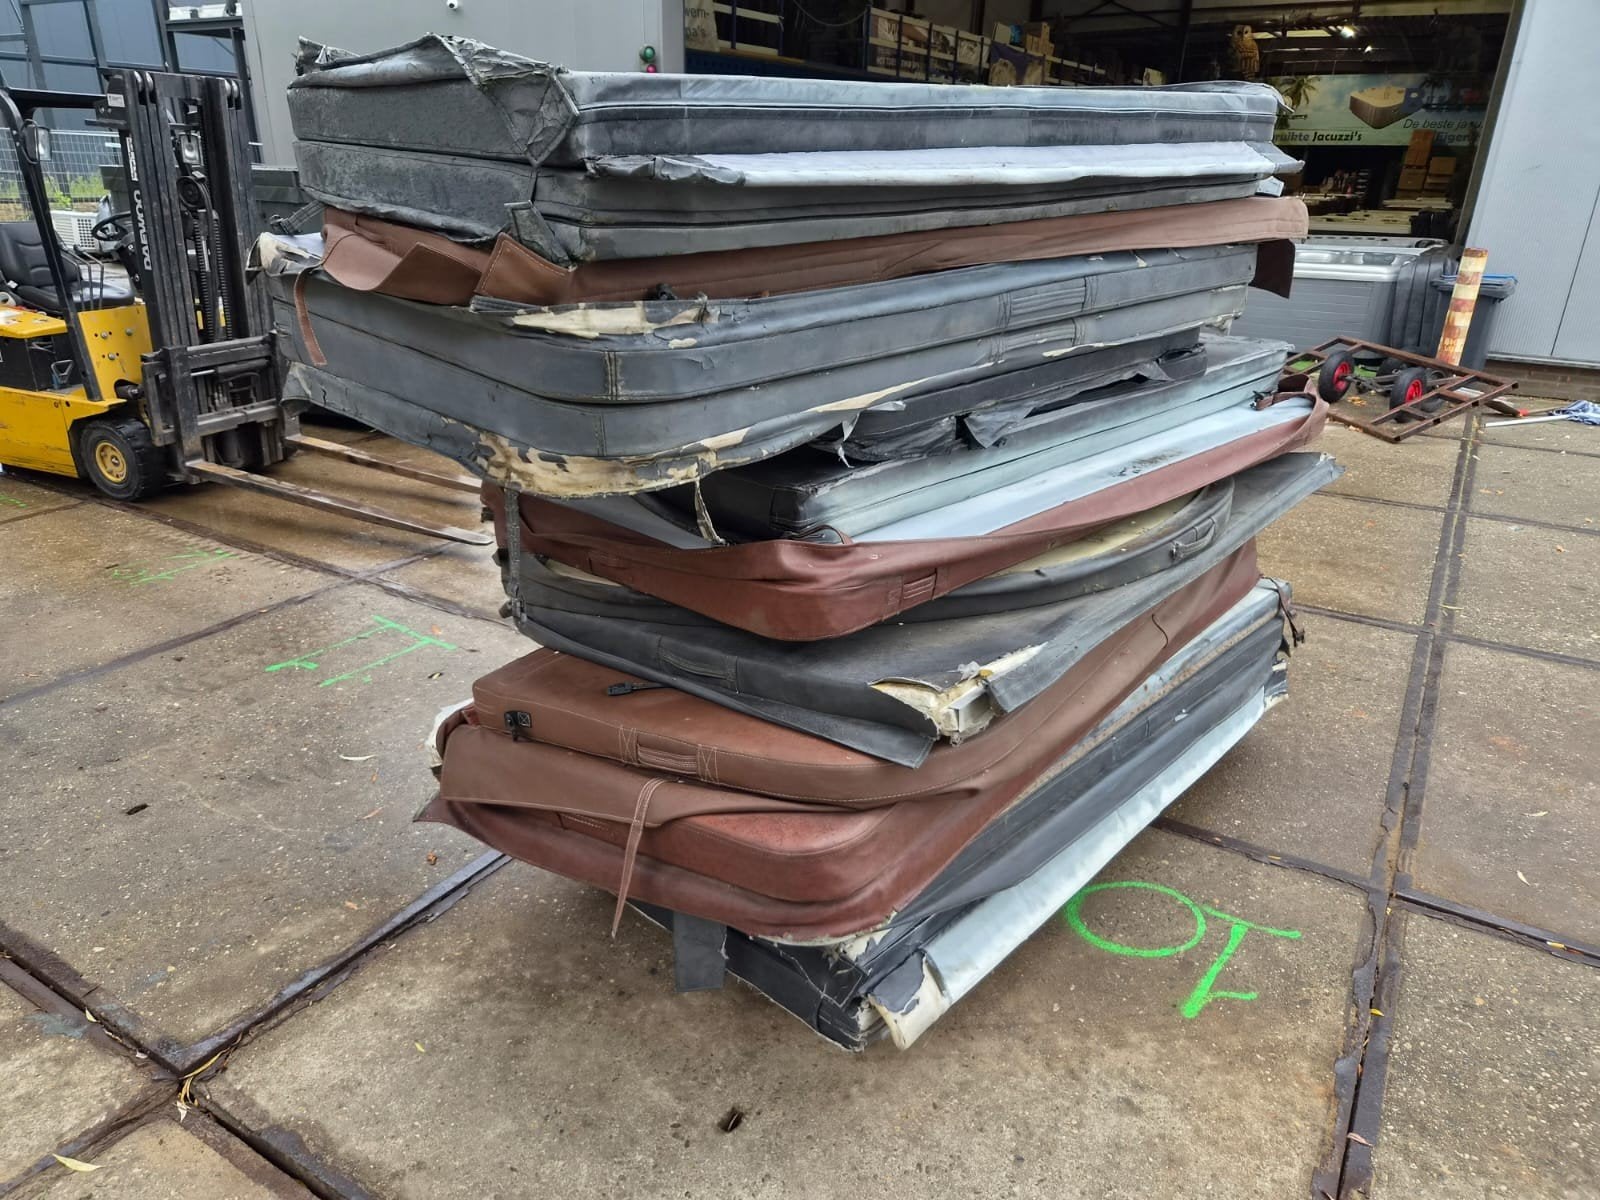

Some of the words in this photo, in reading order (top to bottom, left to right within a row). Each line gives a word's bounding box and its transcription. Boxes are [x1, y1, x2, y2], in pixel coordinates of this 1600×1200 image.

[1403, 119, 1419, 128] De
[1312, 131, 1362, 142] Jacuzzi's
[134, 190, 152, 270] DAEWOO
